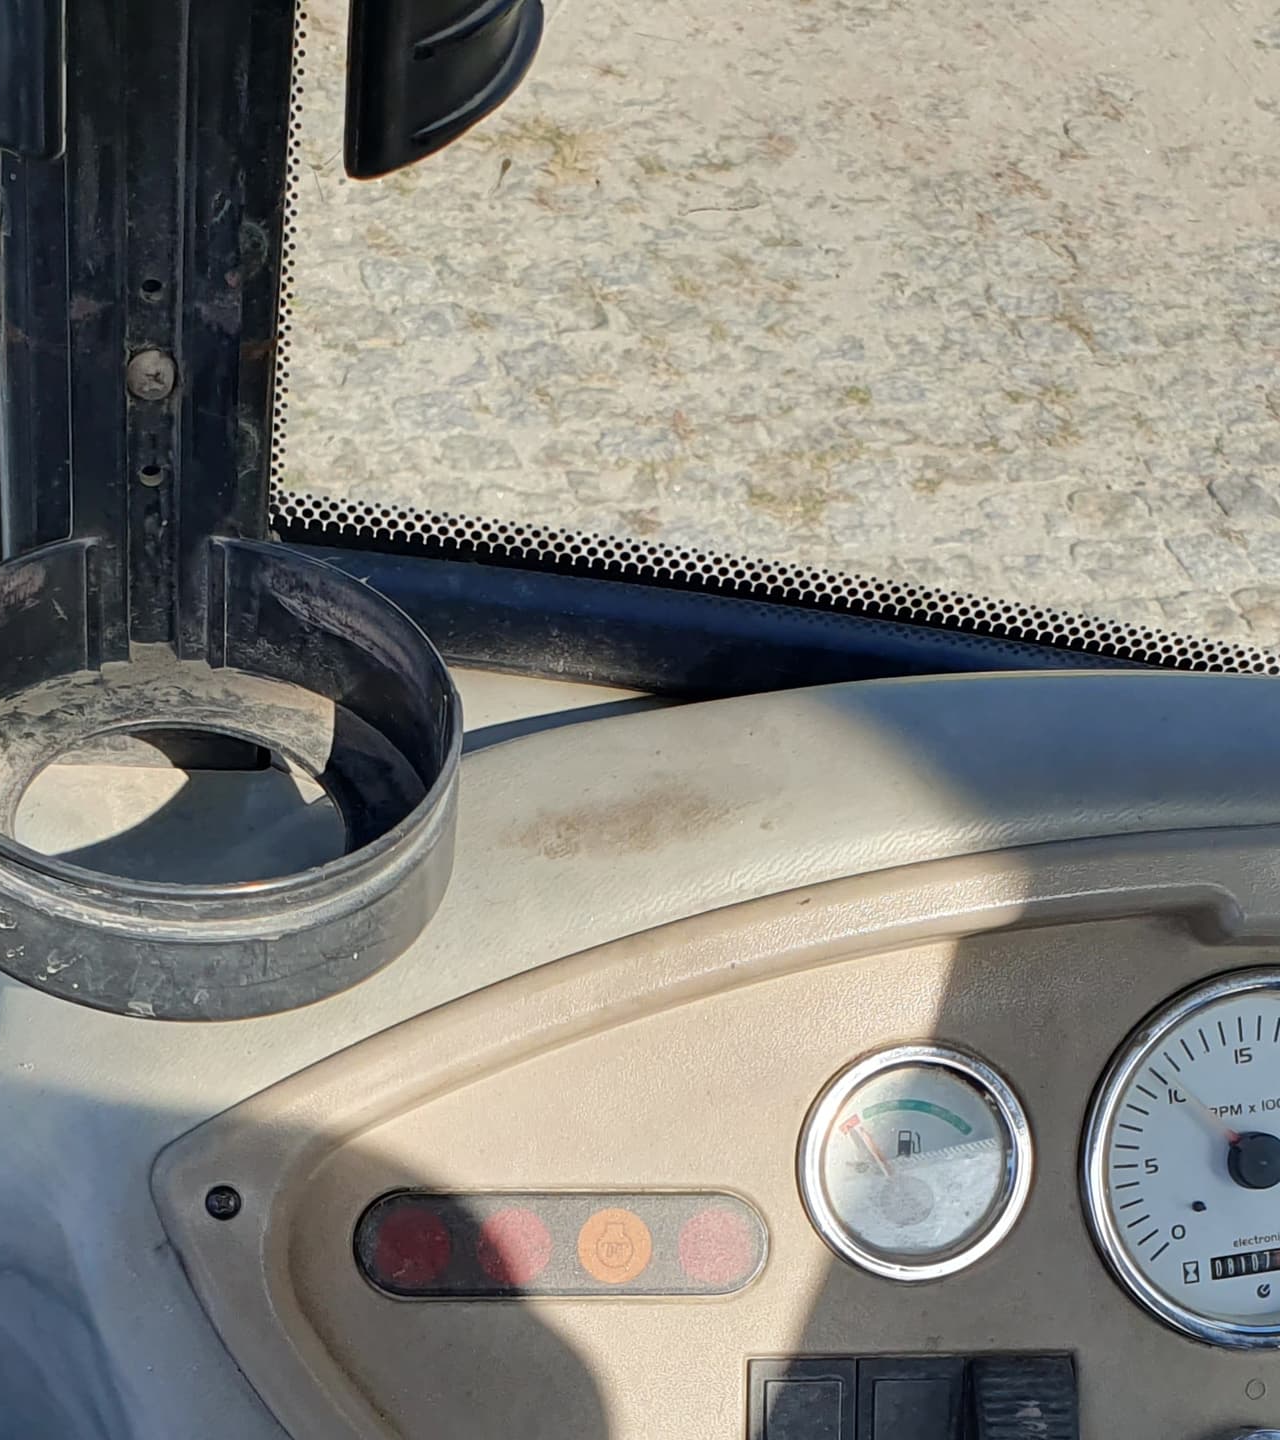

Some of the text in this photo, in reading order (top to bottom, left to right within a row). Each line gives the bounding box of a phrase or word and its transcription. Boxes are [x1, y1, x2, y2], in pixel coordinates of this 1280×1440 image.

[1234, 1048, 1252, 1064] 15
[1145, 1159, 1159, 1174] 5
[1172, 1225, 1186, 1240] 0
